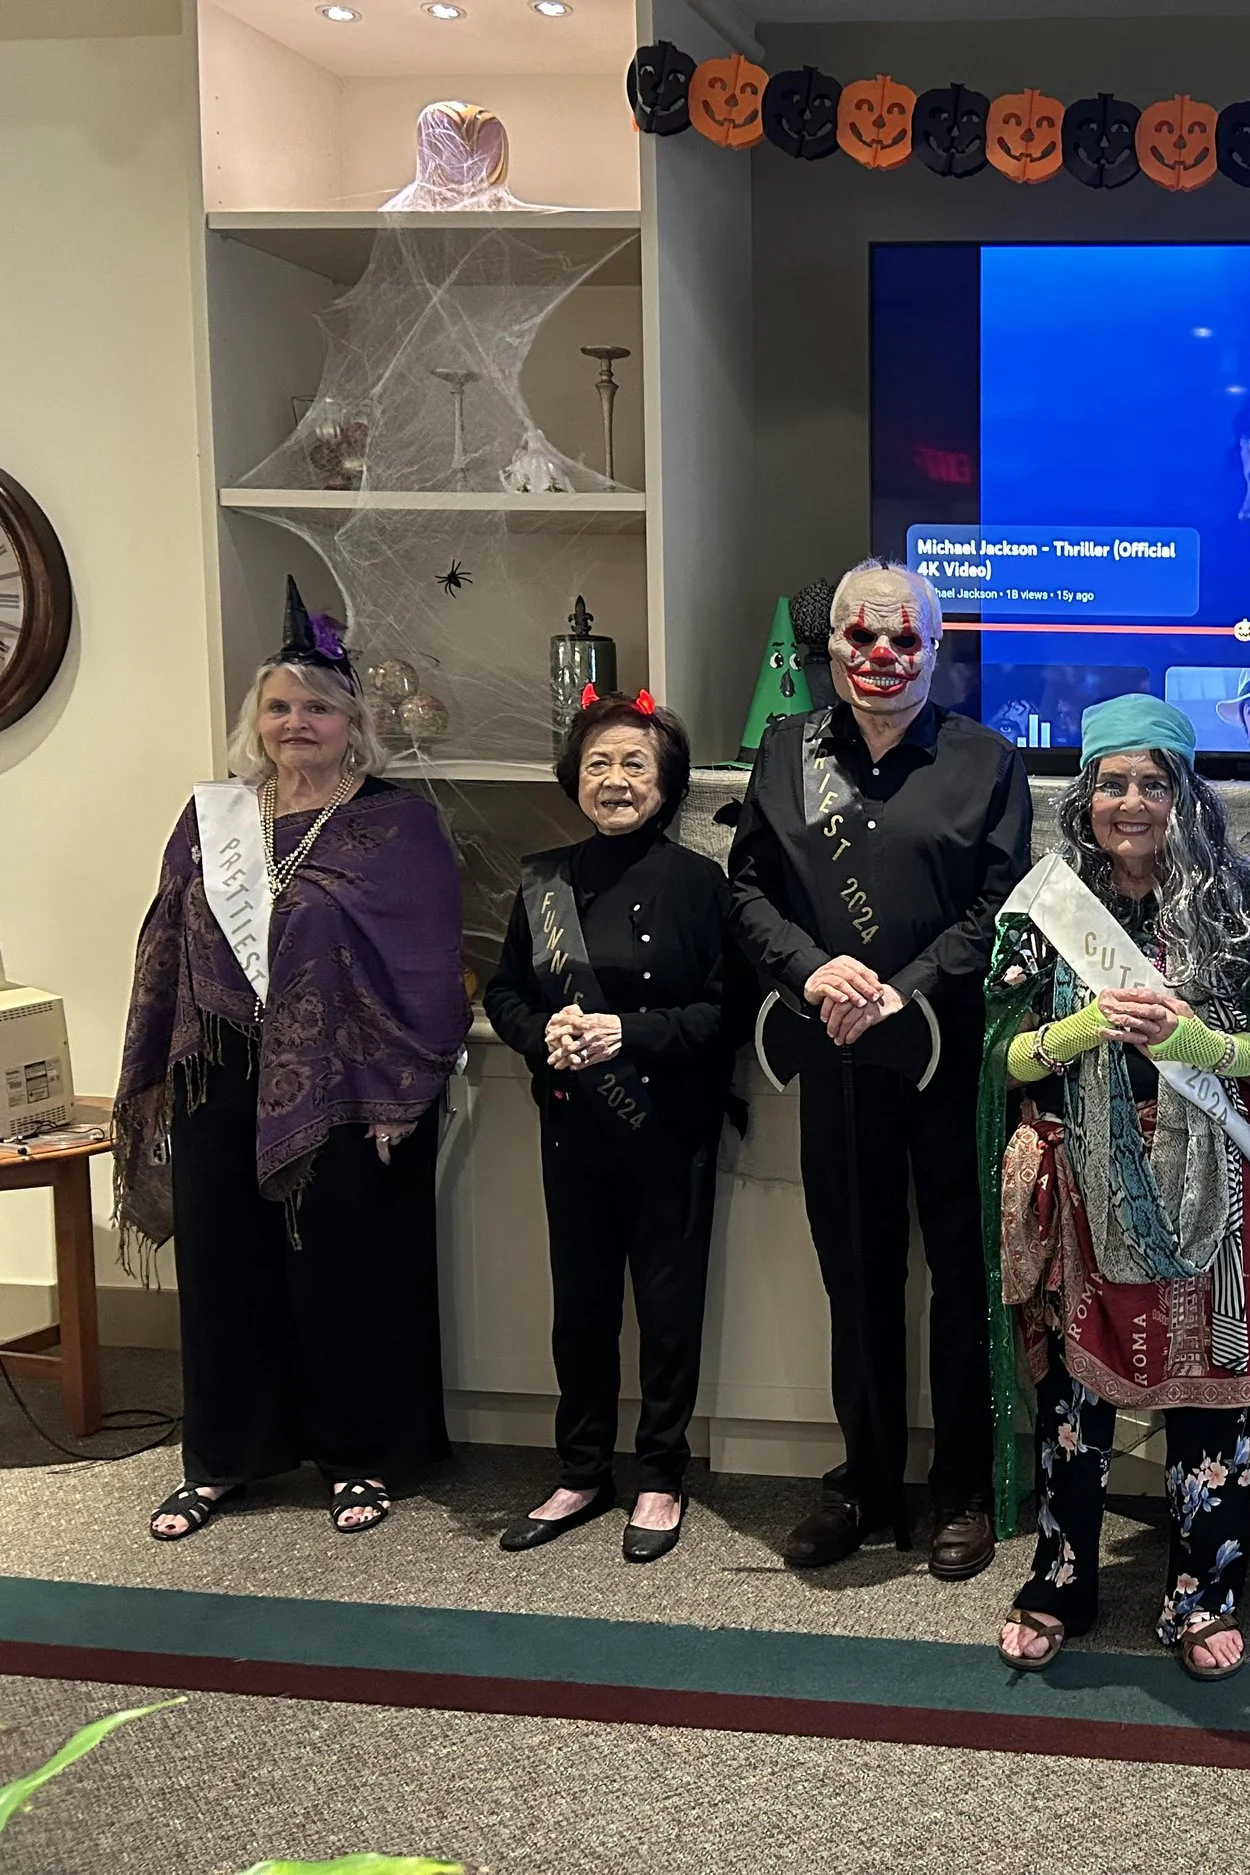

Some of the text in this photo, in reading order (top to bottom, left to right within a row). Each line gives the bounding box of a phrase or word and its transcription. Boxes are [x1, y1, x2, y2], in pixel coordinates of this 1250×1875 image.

[917, 538, 977, 556] Michael
[979, 540, 1038, 557] Jackson
[1053, 540, 1110, 558] Thriller
[1113, 539, 1177, 561] (Official
[917, 560, 992, 580] 4K Video)
[935, 587, 1095, 603] hael Jackson 1B views 15y ago
[219, 837, 267, 985] PRETTIEST
[839, 877, 880, 945] 2024
[596, 1072, 648, 1131] 2024
[1132, 1313, 1148, 1387] ROMA
